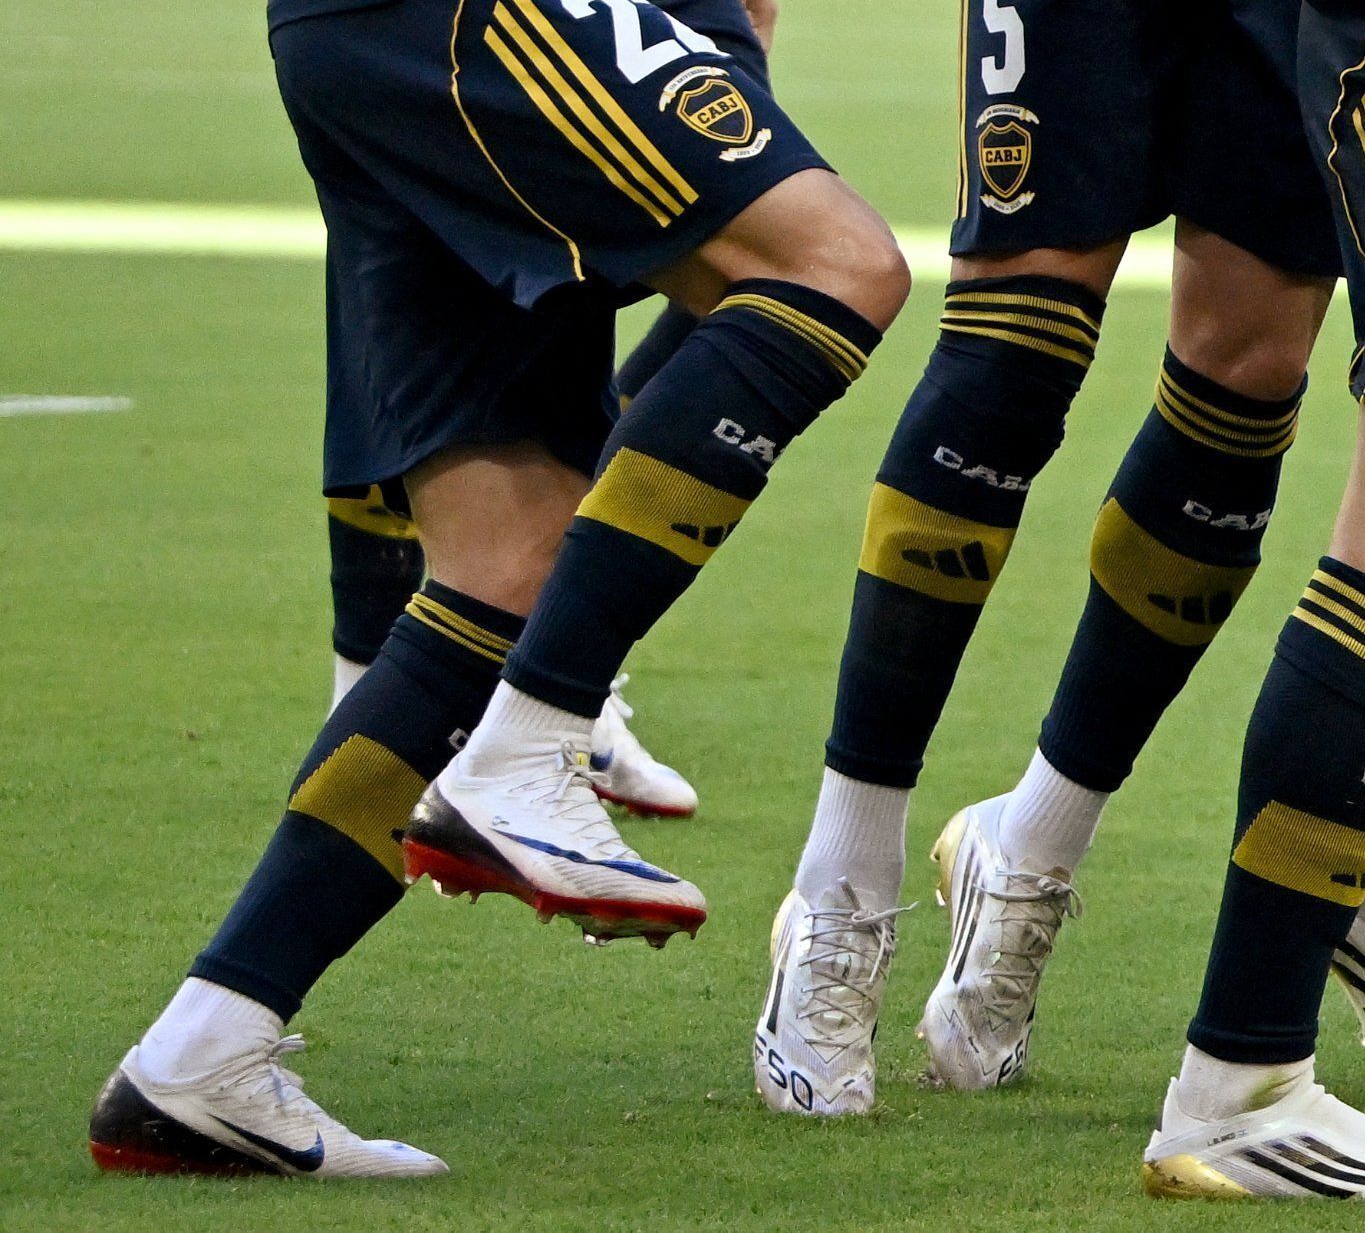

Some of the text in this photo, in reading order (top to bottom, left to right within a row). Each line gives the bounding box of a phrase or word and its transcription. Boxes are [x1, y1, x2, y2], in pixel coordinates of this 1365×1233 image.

[697, 97, 738, 125] CABJ
[985, 148, 1023, 164] CABJ
[713, 417, 787, 465] CA
